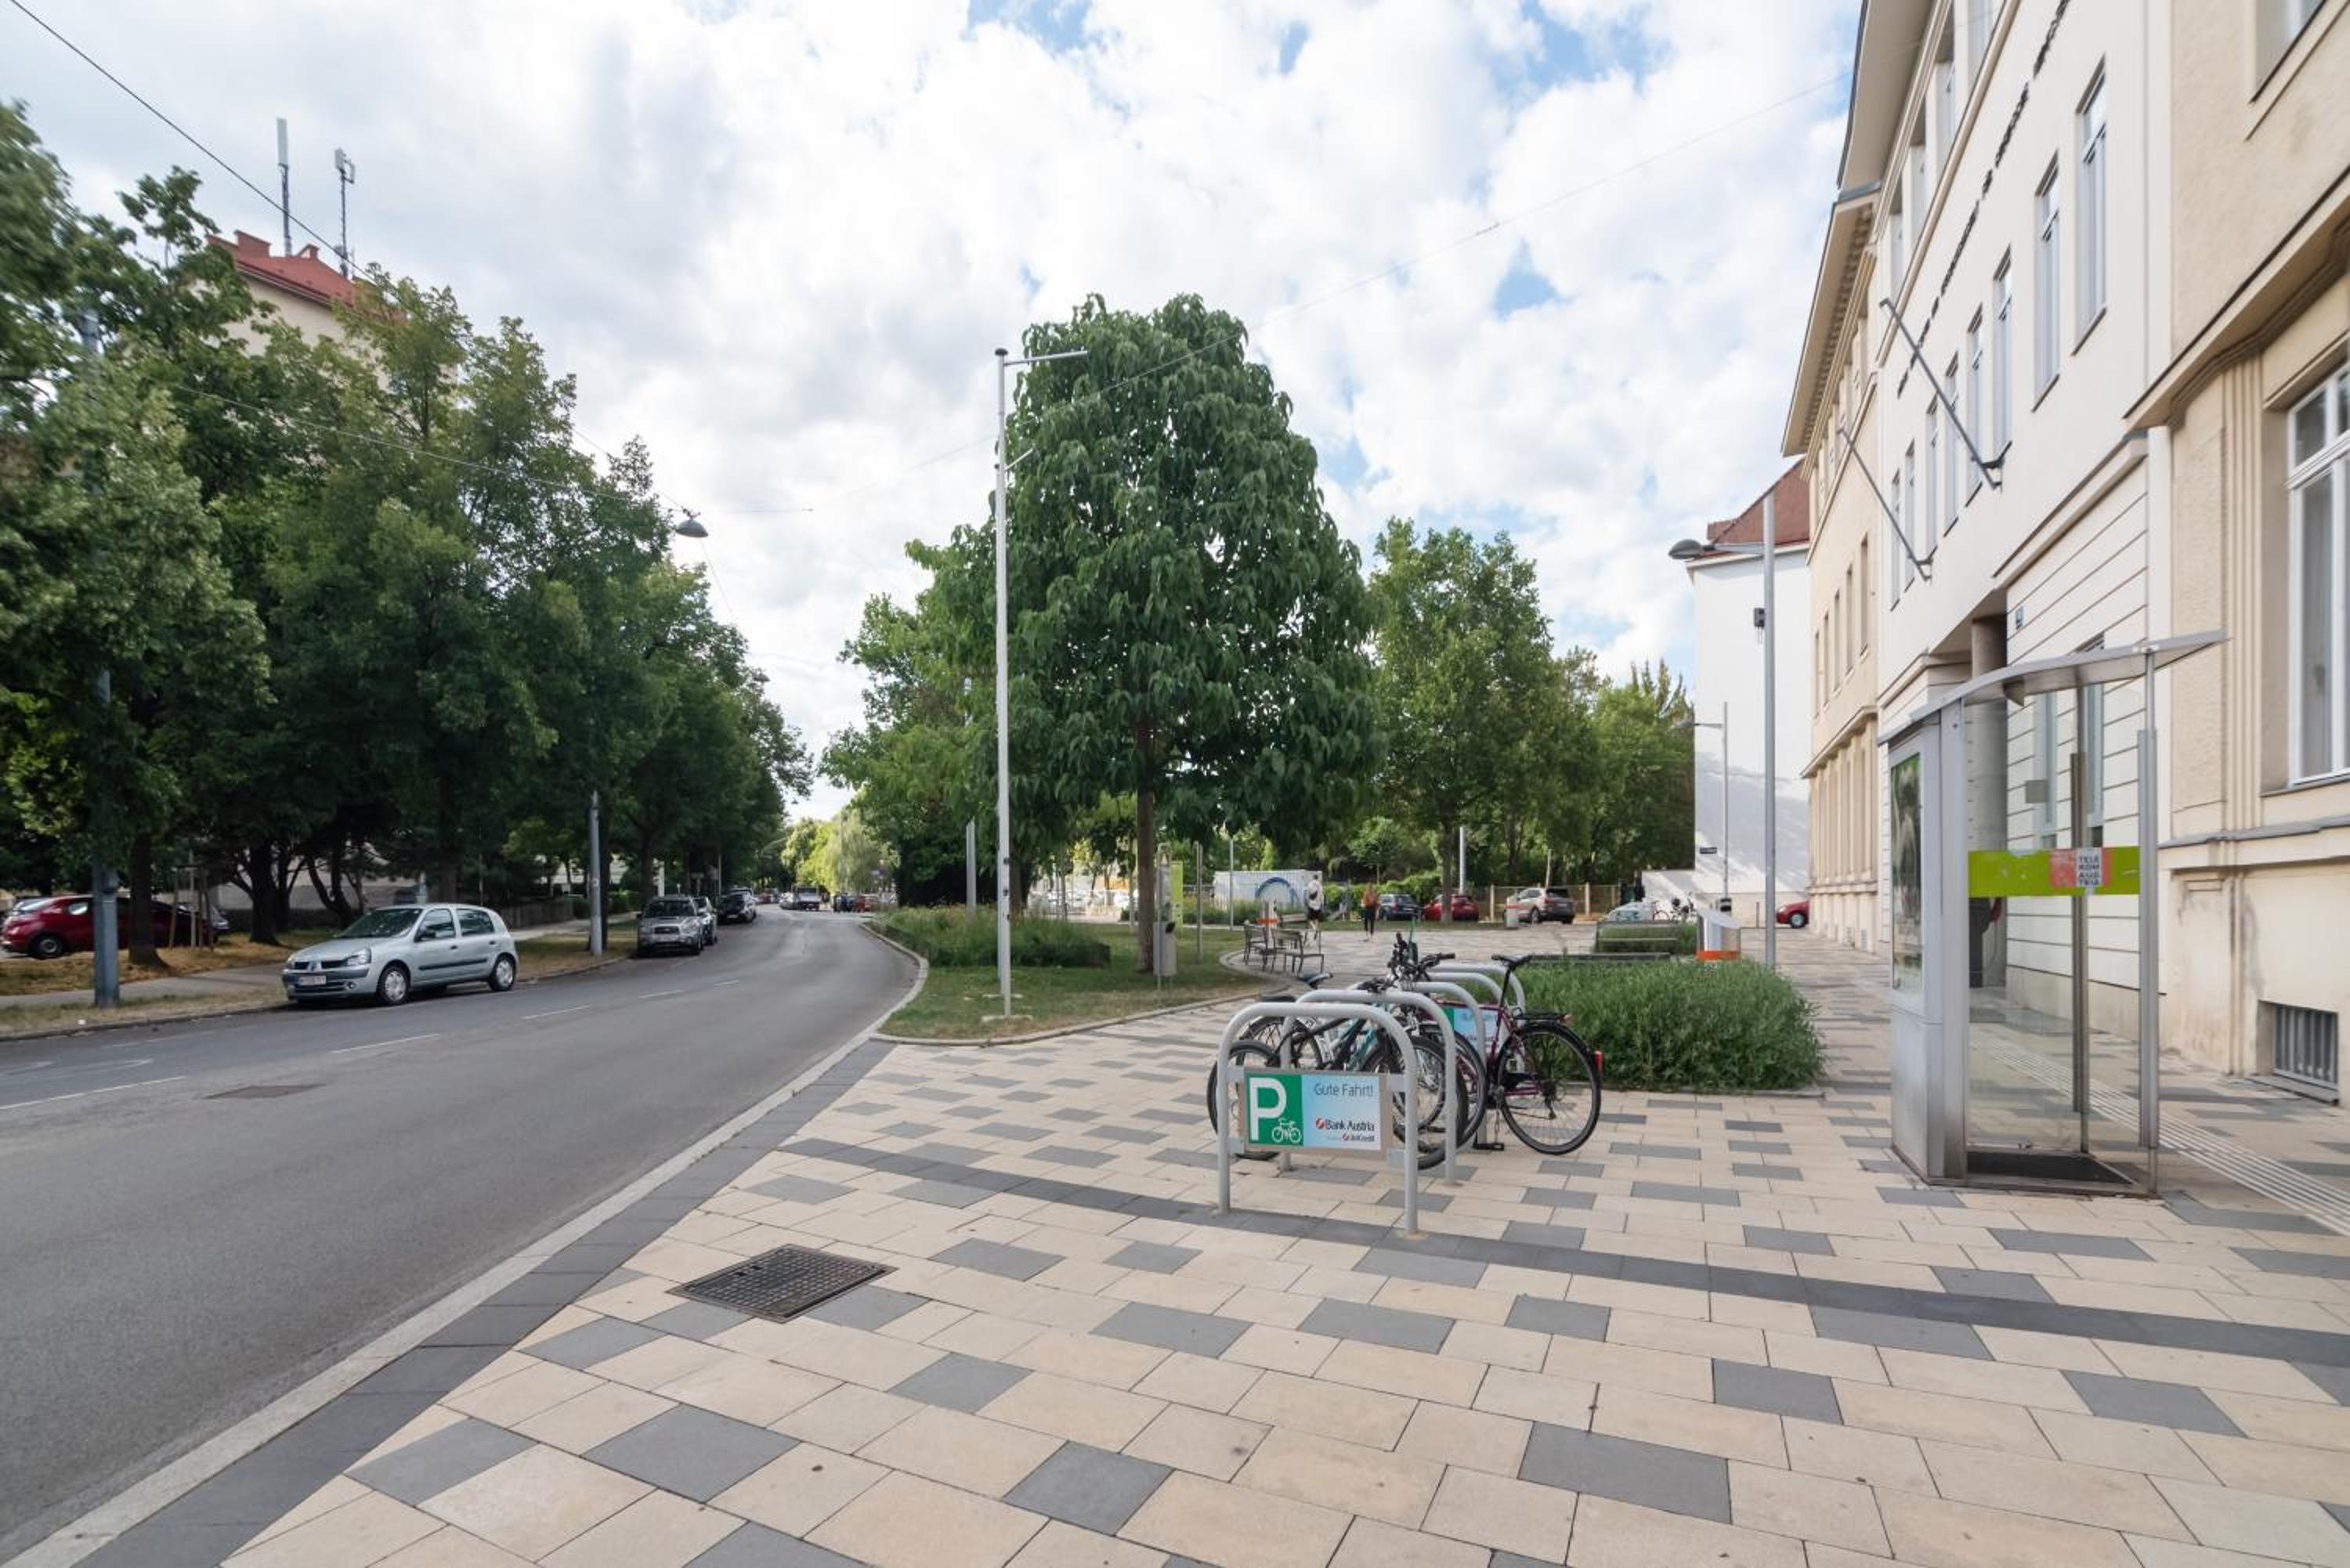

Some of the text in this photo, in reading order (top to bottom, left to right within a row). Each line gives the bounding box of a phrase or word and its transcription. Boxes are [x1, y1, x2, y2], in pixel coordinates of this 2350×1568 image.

[1314, 1083, 1373, 1097] Gute Fahrt!
[1249, 1078, 1287, 1140] P
[1325, 1118, 1375, 1132] Bank Austria
